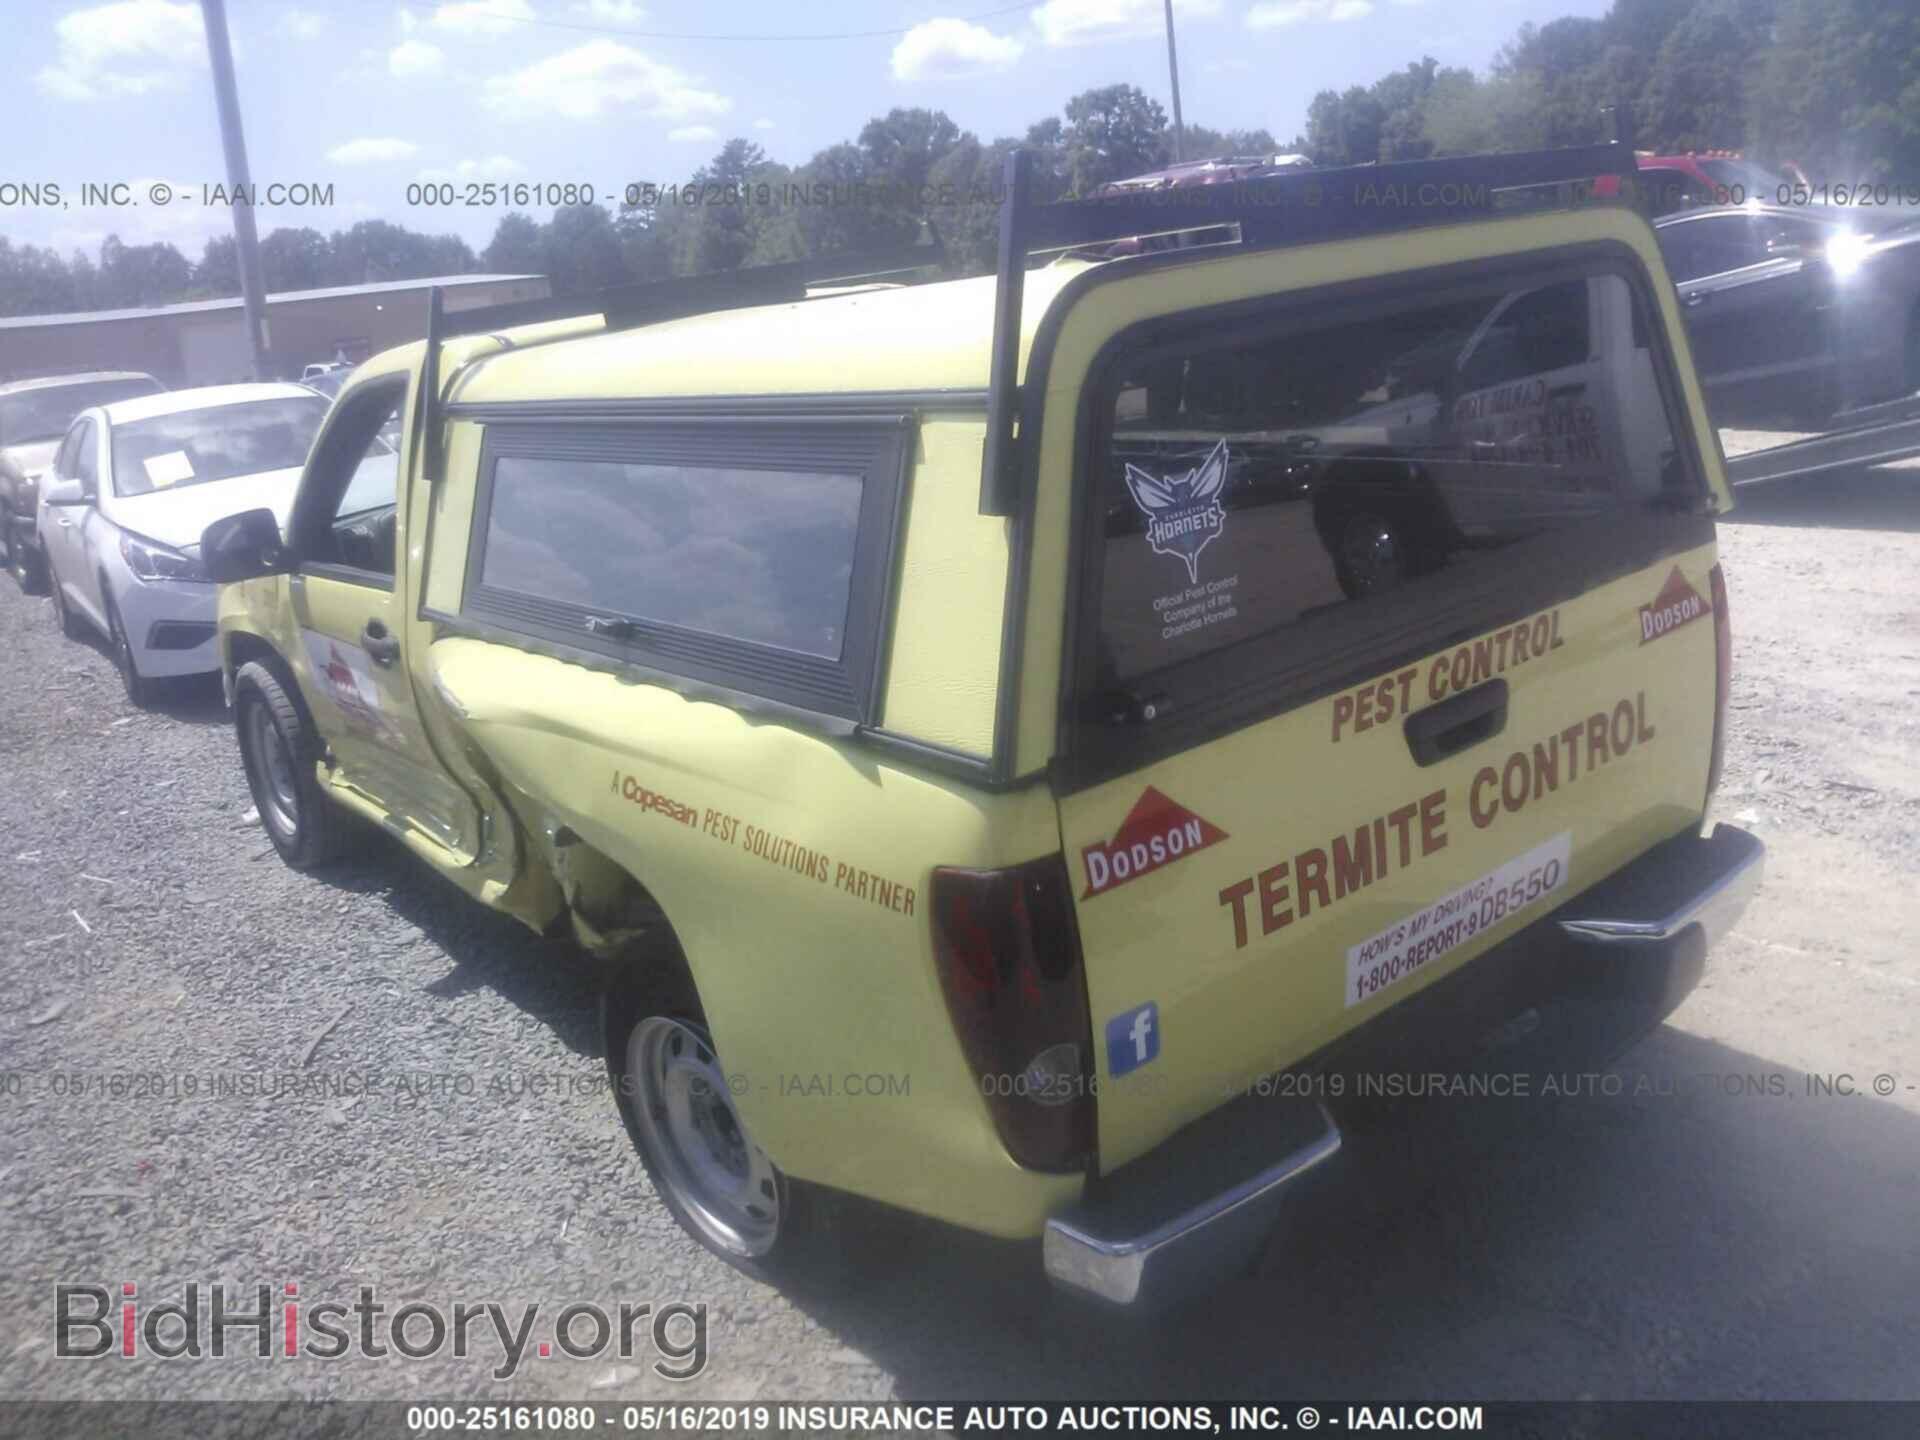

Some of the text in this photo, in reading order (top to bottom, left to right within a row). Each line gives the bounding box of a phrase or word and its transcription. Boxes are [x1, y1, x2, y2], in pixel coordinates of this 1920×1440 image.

[1154, 507, 1218, 543] HORNETS
[1163, 592, 1232, 623] Company of the
[1185, 585, 1206, 601] Pest
[1207, 574, 1239, 594] Control
[1331, 609, 1565, 744] PEST CONTROL
[610, 770, 917, 917] A Copesan PEST SOLUTIONS PARTNER
[1218, 691, 1656, 949] TERMITE CONTROL
[1407, 911, 1433, 941] MY
[1433, 877, 1495, 925] DRIVING?
[1479, 858, 1561, 930] DB550
